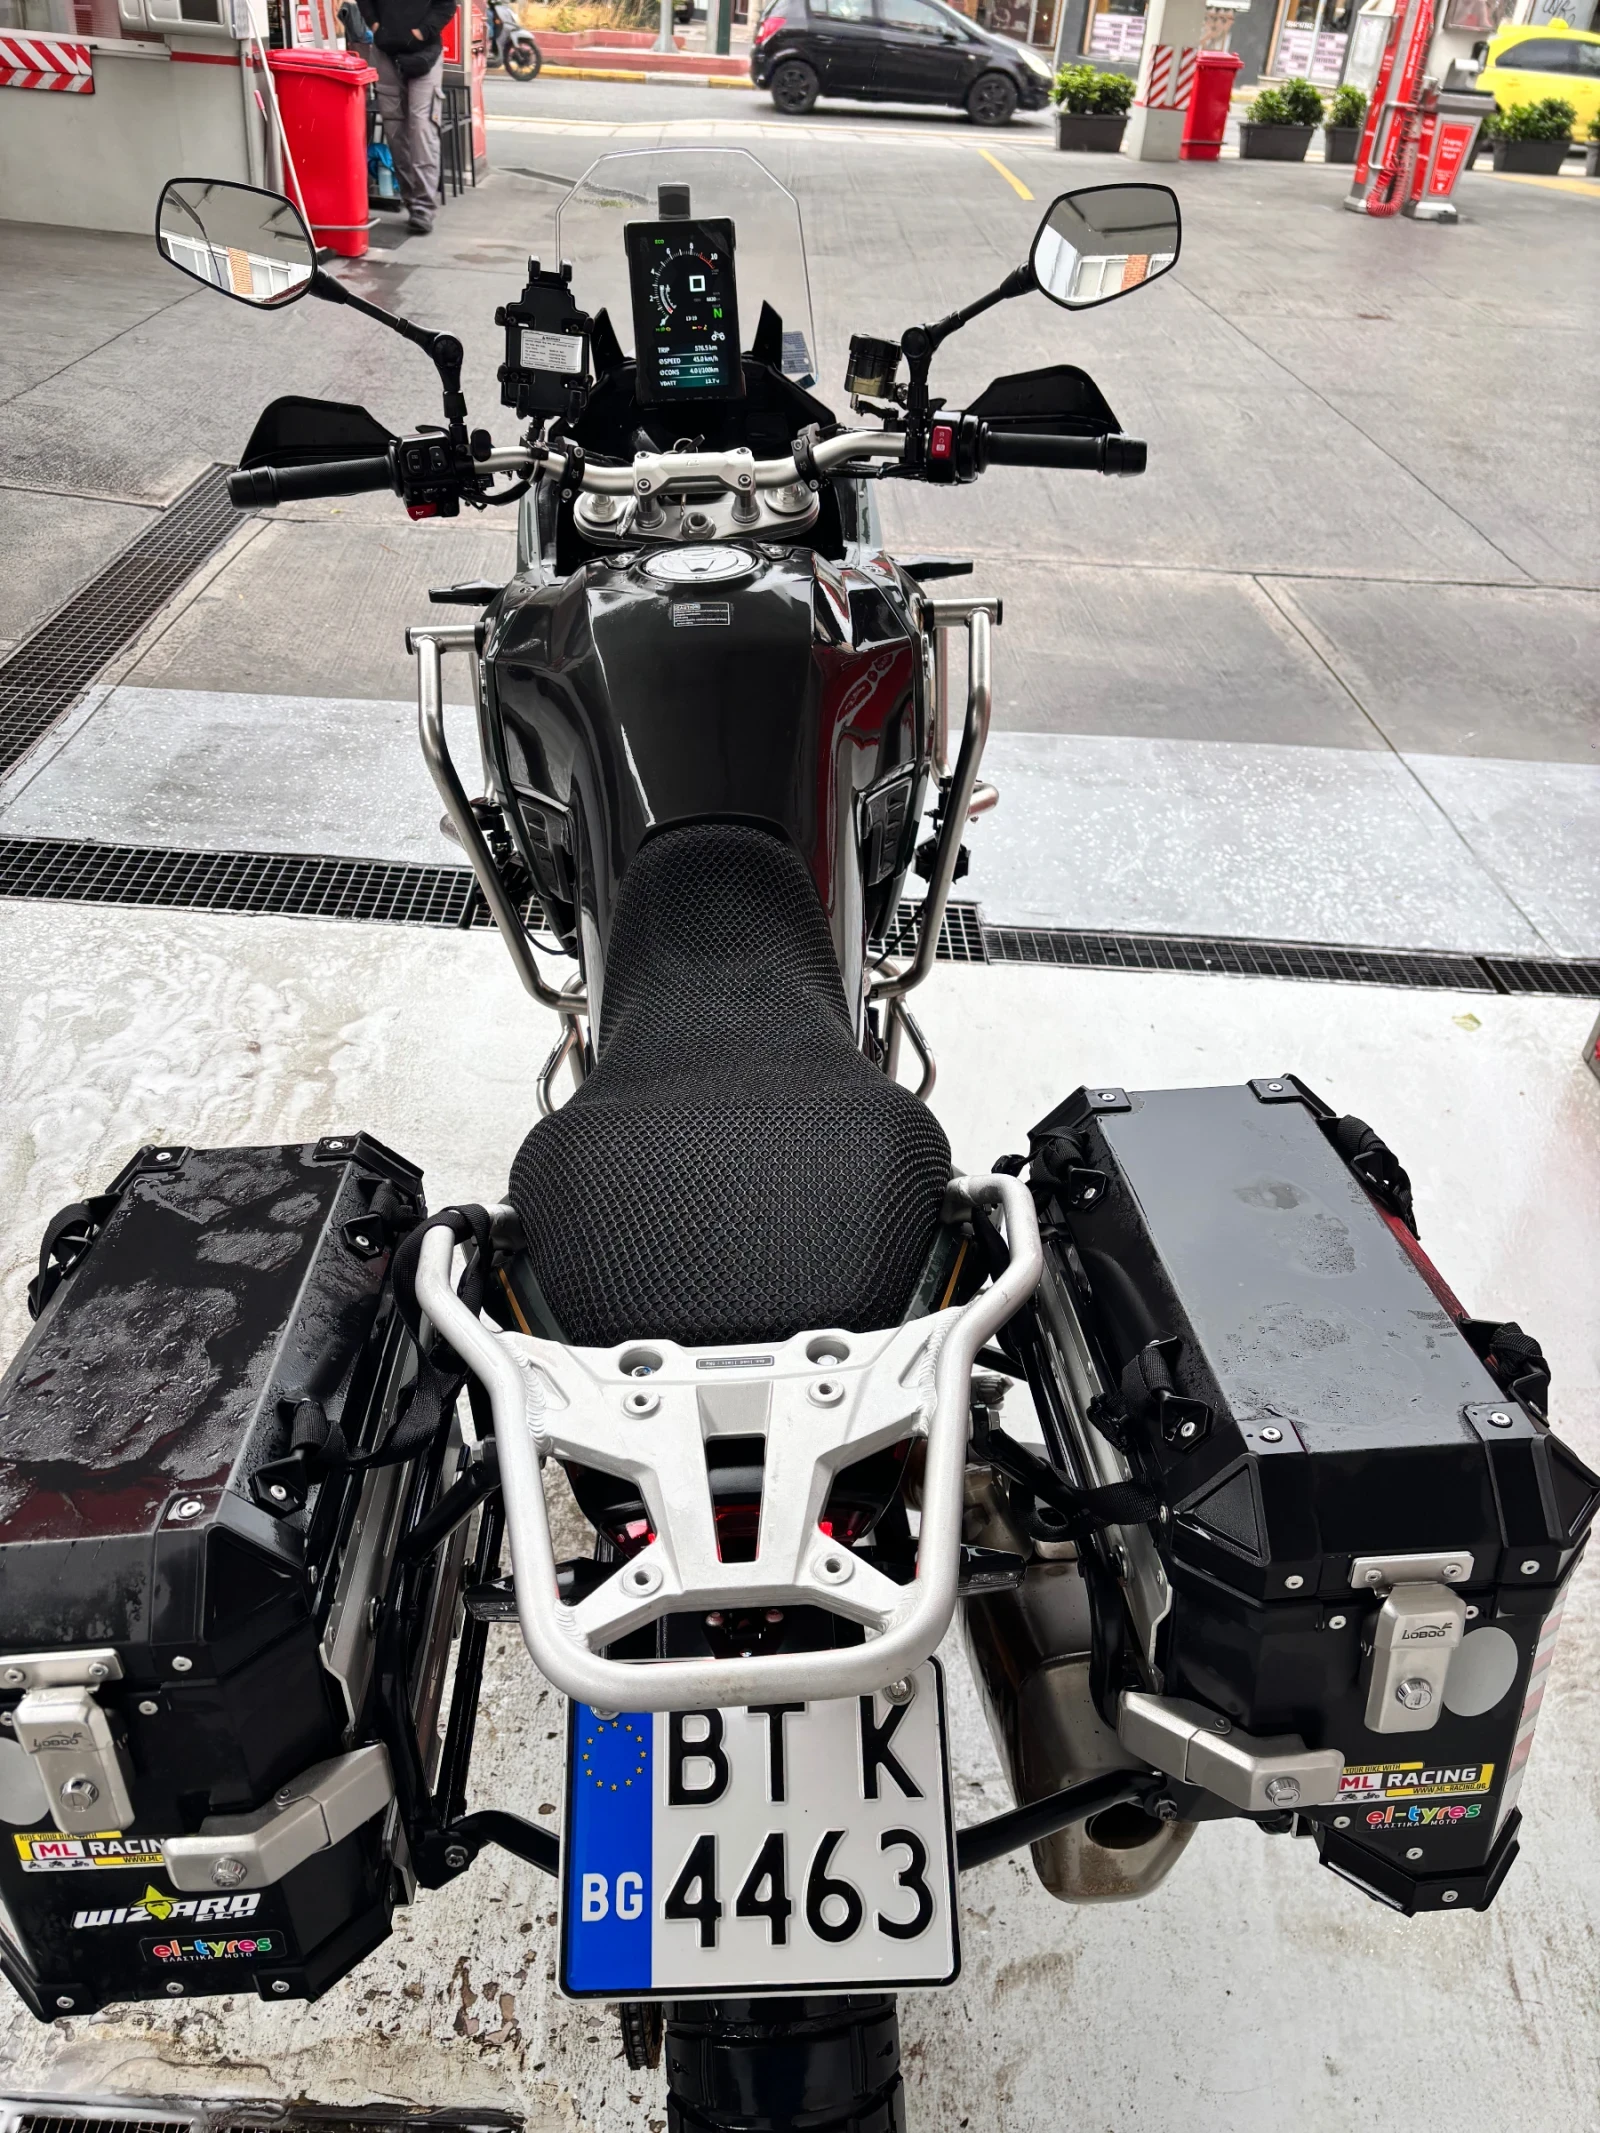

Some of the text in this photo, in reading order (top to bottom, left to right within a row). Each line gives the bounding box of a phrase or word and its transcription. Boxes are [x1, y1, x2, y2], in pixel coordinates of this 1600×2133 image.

[714, 308, 722, 318] N
[657, 346, 670, 354] TRIP
[666, 1695, 925, 1807] BT K
[1382, 1764, 1401, 1772] WITH
[1340, 1768, 1477, 1790] ML RACING
[1366, 1804, 1482, 1825] el-tyres
[1370, 1821, 1420, 1830] ΕΛΑΣΤΙΚΑ
[38, 1838, 165, 1858] ML RACIN
[123, 1855, 164, 1864] WWW.ML-
[581, 1870, 643, 1922] BG
[663, 1828, 935, 1948] 4463
[194, 1910, 256, 1922] ECU
[152, 1938, 272, 1959] el-tyres
[162, 1954, 214, 1964] ΕΛΑΣΤΙΚΑ
